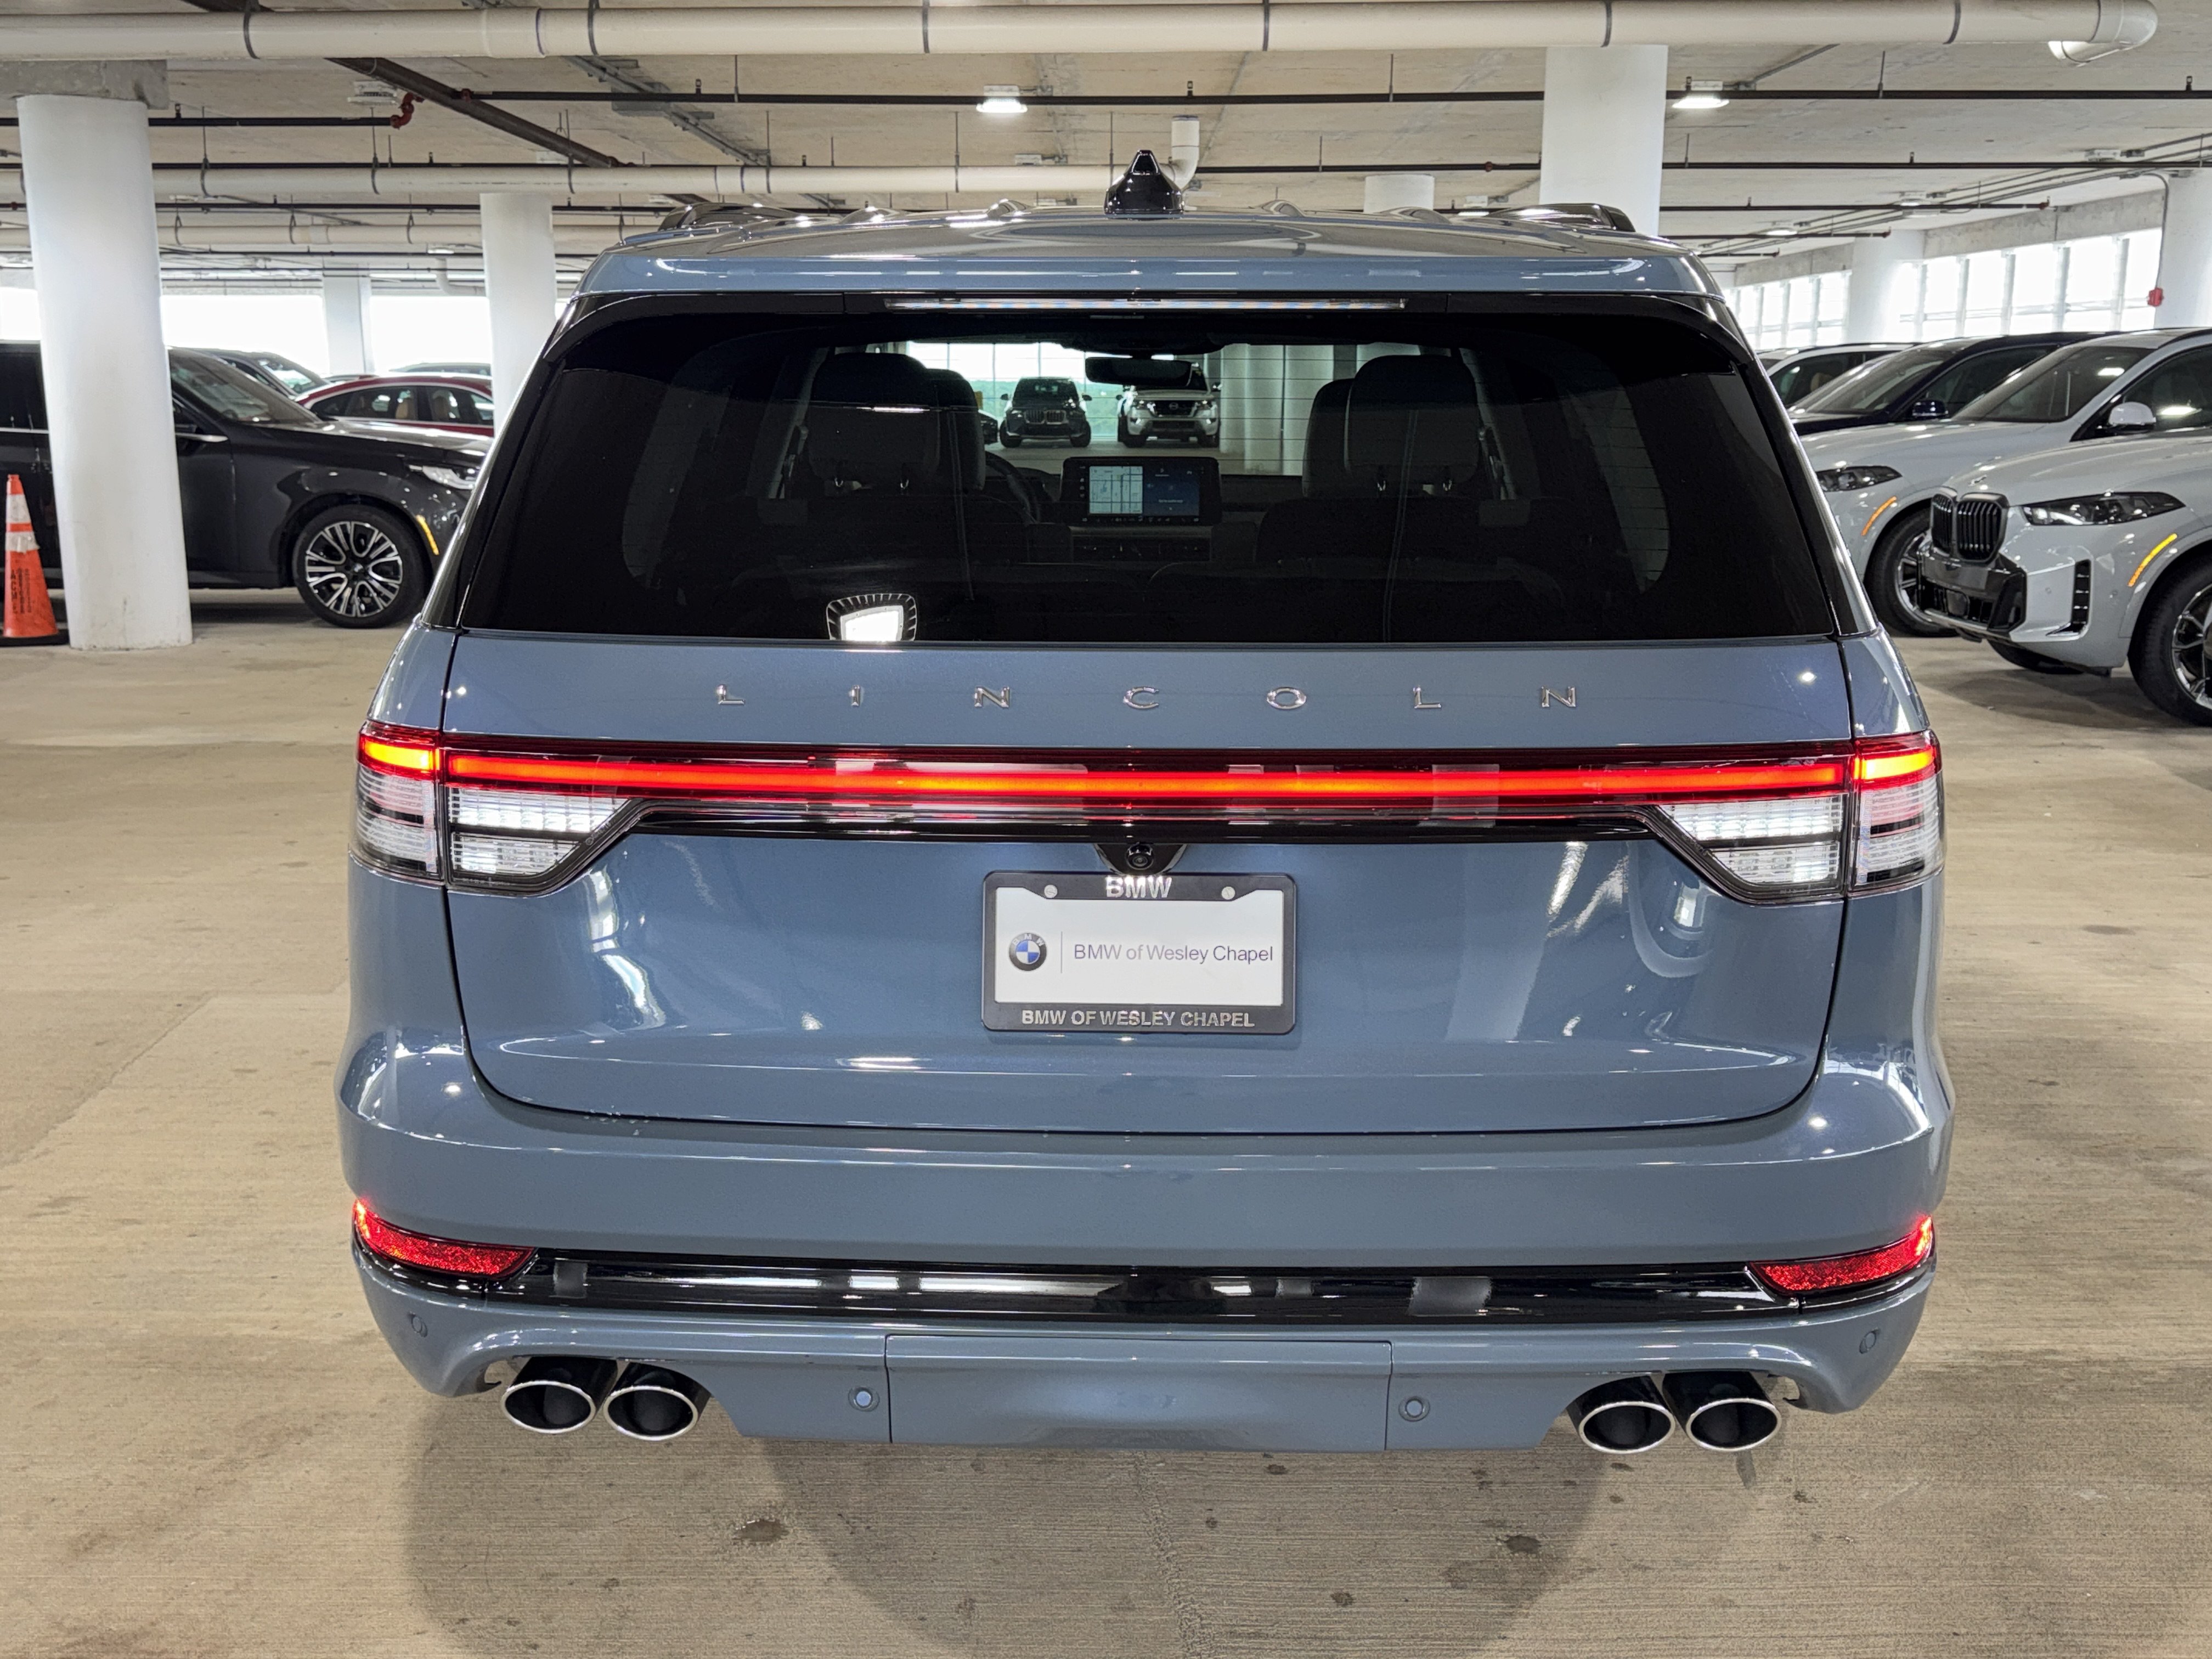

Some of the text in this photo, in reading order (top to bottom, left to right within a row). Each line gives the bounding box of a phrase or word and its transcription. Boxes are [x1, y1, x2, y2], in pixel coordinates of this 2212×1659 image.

[716, 684, 1577, 709] LINCOLN
[1105, 874, 1172, 899] BMW
[1012, 933, 1045, 947] BMW
[1074, 944, 1273, 965] BMW of Wesley Chapel
[1022, 1009, 1255, 1028] BMW OF WESLEY CHAPEL
